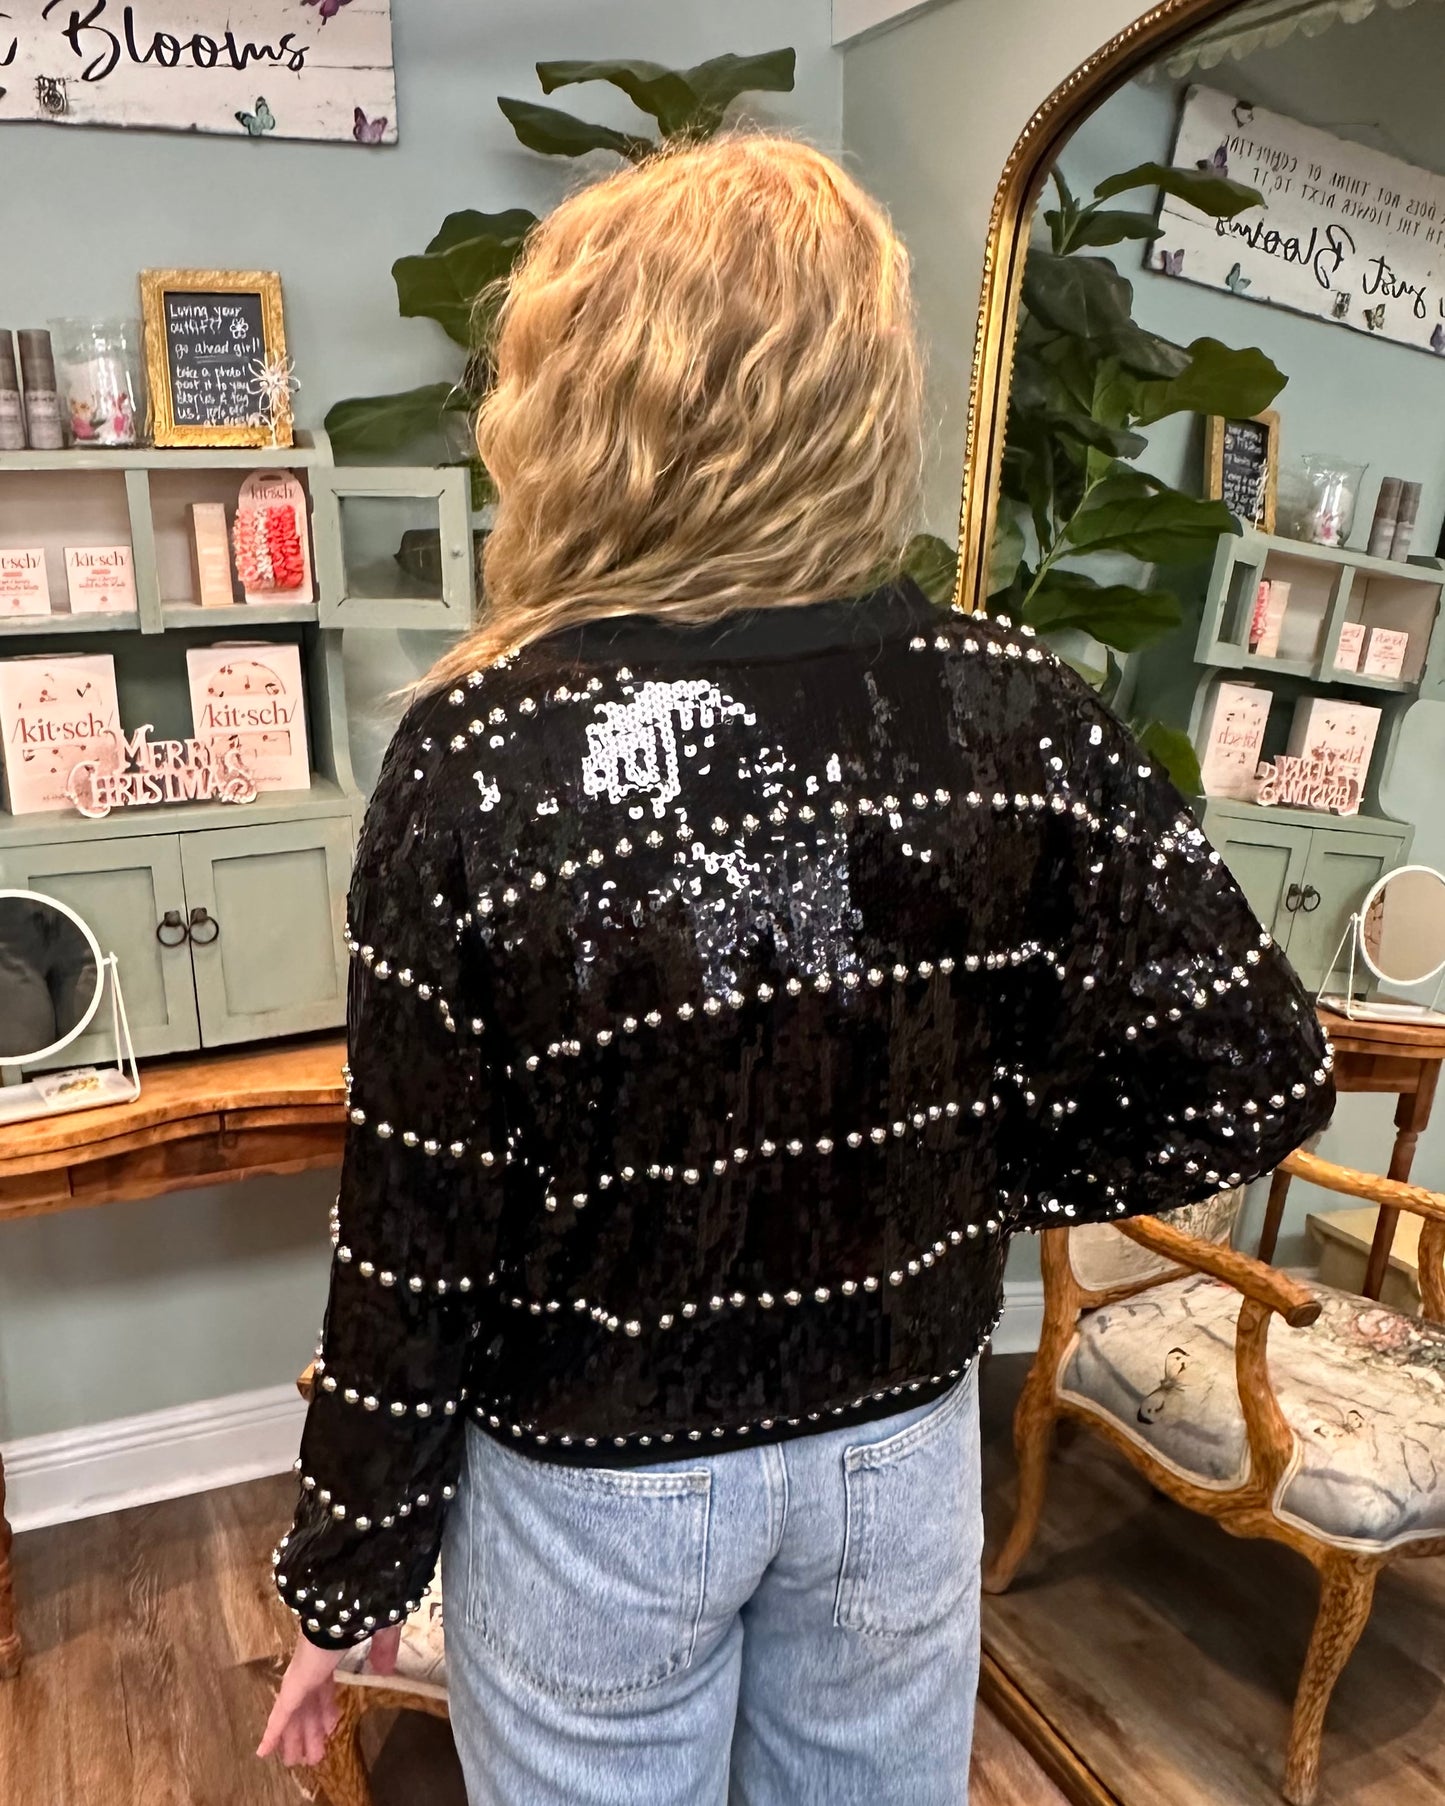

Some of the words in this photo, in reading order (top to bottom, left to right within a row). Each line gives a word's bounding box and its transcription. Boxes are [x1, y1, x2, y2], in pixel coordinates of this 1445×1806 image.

[42, 0, 310, 81] Blooms
[170, 303, 208, 321] Loving
[213, 305, 242, 322] your
[174, 343, 189, 360] go
[194, 340, 229, 355] ahead
[201, 367, 211, 378] a
[104, 723, 217, 775] MERRY
[64, 758, 258, 819] CHRISTMAS
